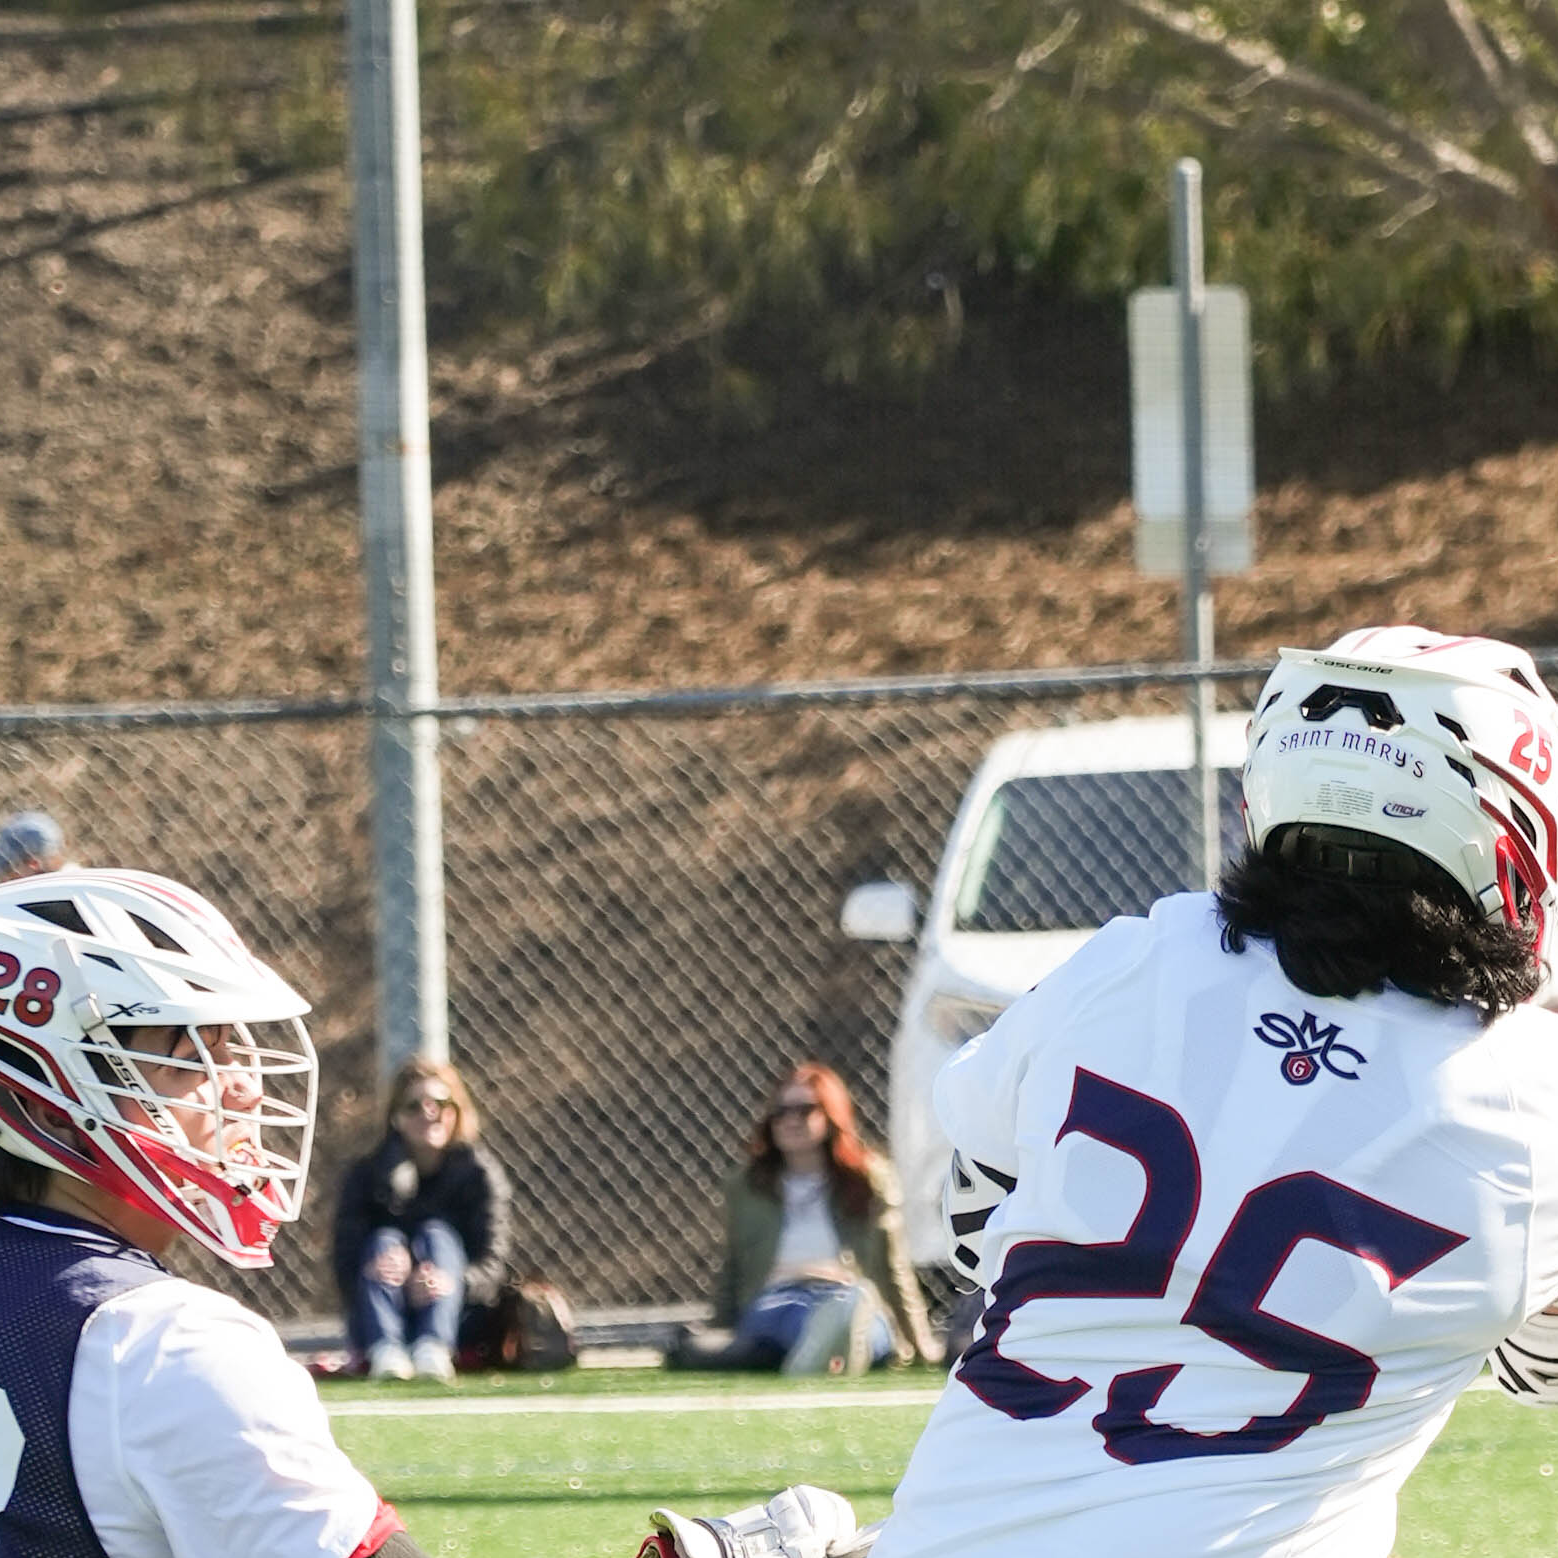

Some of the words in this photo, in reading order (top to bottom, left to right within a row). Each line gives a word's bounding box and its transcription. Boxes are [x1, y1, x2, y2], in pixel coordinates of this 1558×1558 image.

[1313, 657, 1393, 675] cascade
[1278, 729, 1334, 753] SAINT
[1341, 730, 1425, 779] MARY'S
[1509, 708, 1553, 786] 25
[1253, 1009, 1369, 1081] SMC
[98, 1041, 175, 1137] cascad
[956, 1066, 1470, 1466] 25
